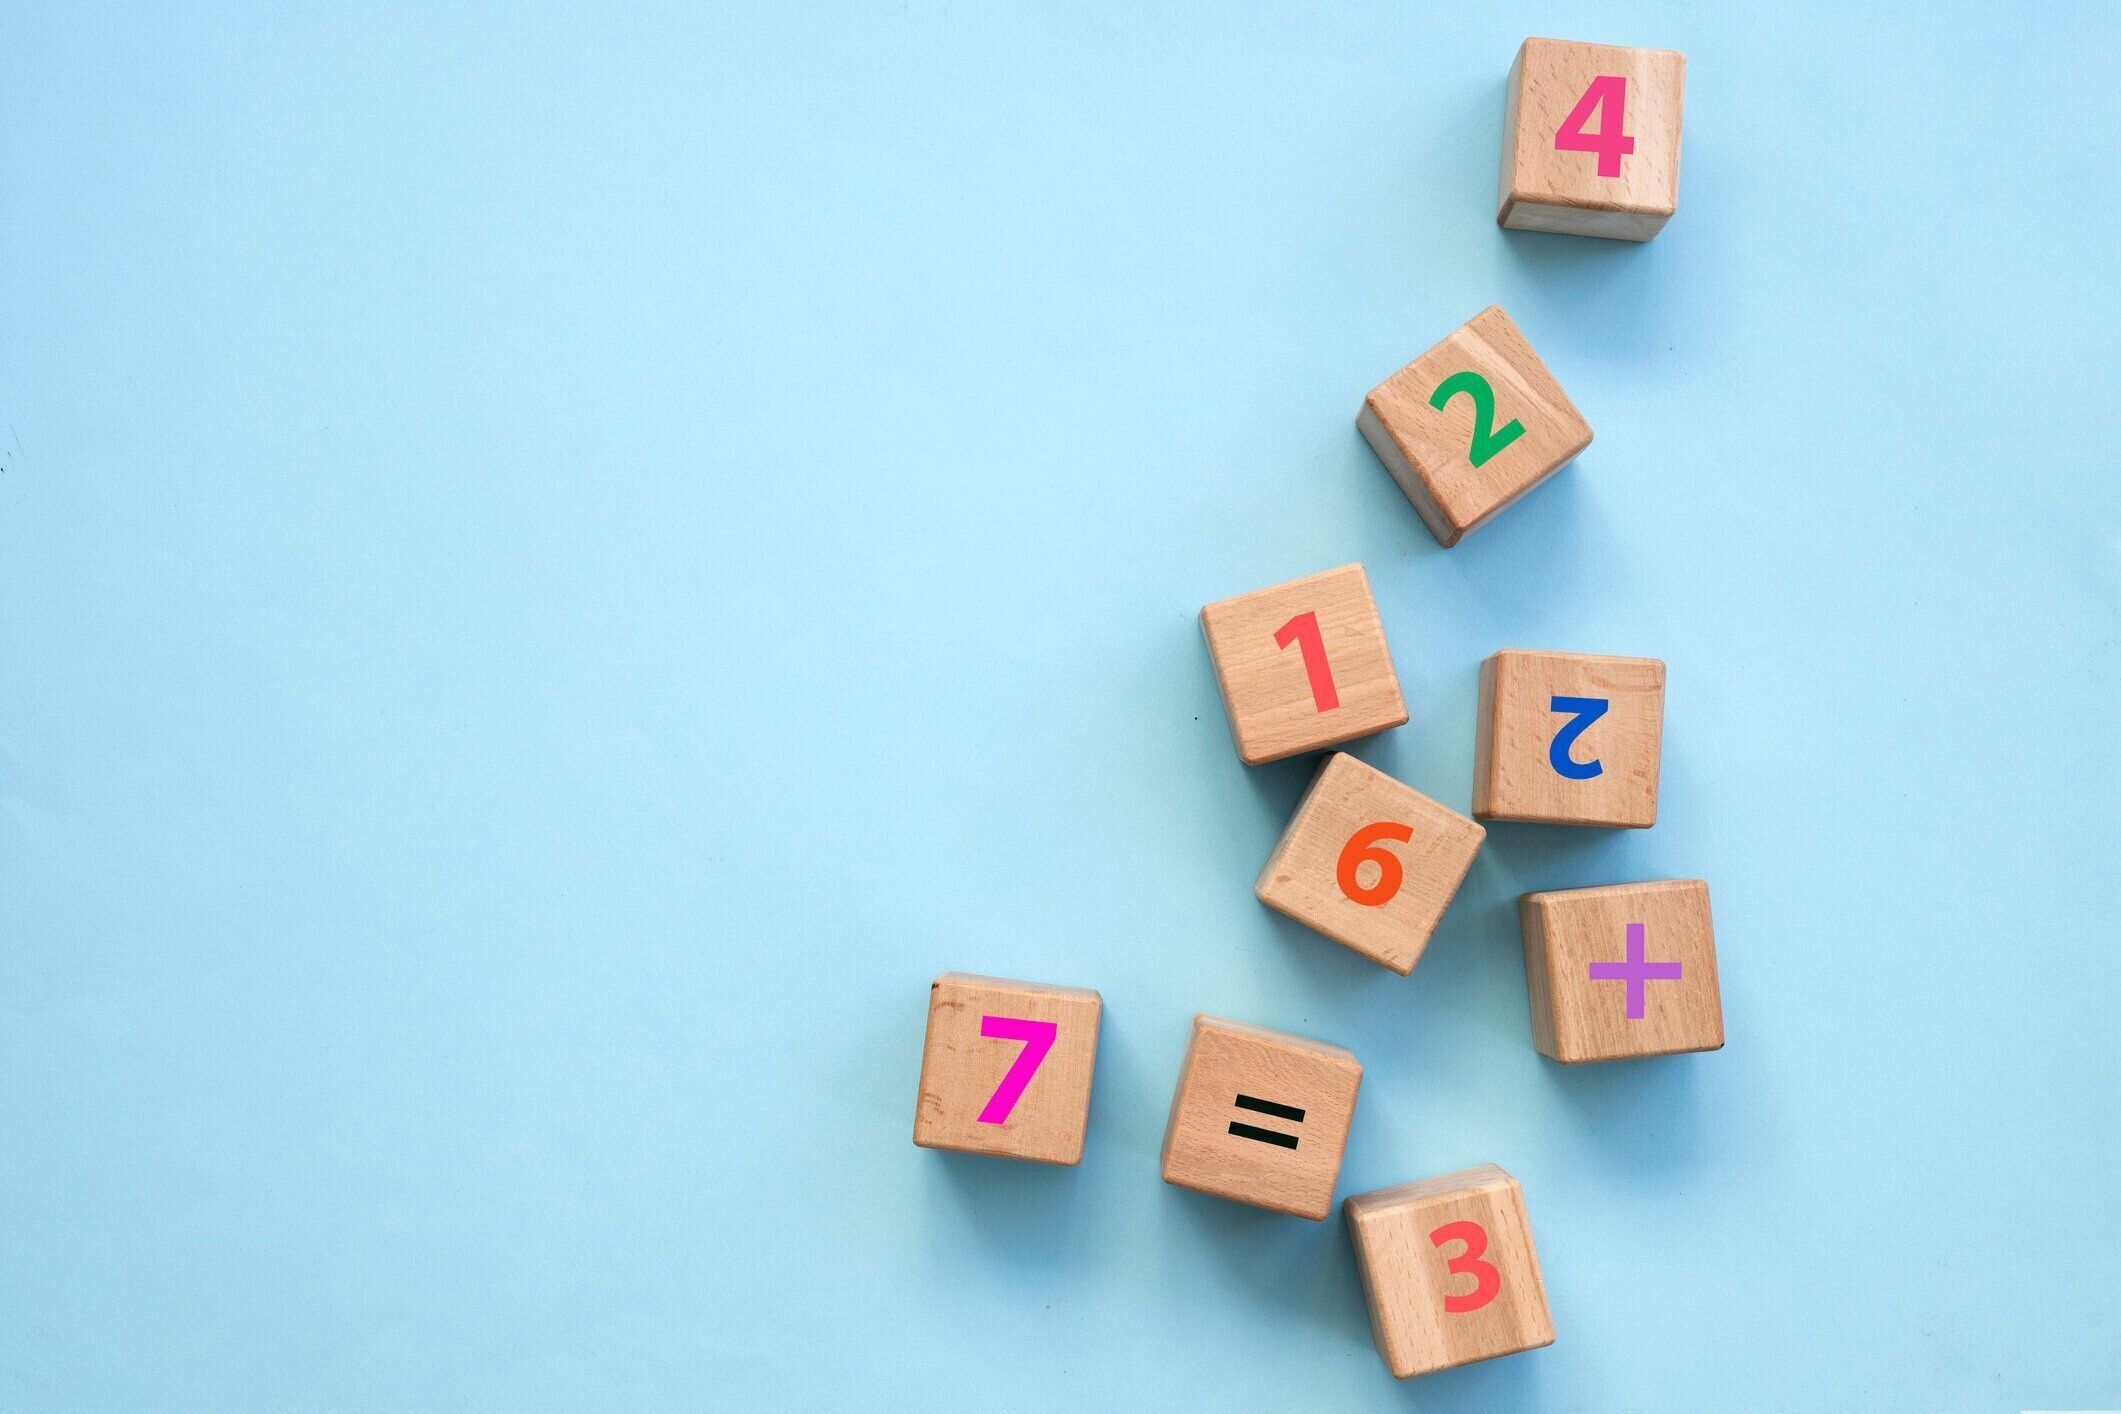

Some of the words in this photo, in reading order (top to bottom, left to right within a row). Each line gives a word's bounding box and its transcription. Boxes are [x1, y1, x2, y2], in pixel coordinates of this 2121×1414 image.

[1554, 75, 1635, 178] 4
[1429, 371, 1526, 468] 2
[1273, 611, 1340, 713] 1
[1549, 695, 1609, 780] 2
[1336, 821, 1414, 907] 6
[1588, 923, 1683, 1020] +
[976, 1014, 1059, 1125] 7
[1228, 1094, 1306, 1151] =
[1430, 1221, 1502, 1313] 3
